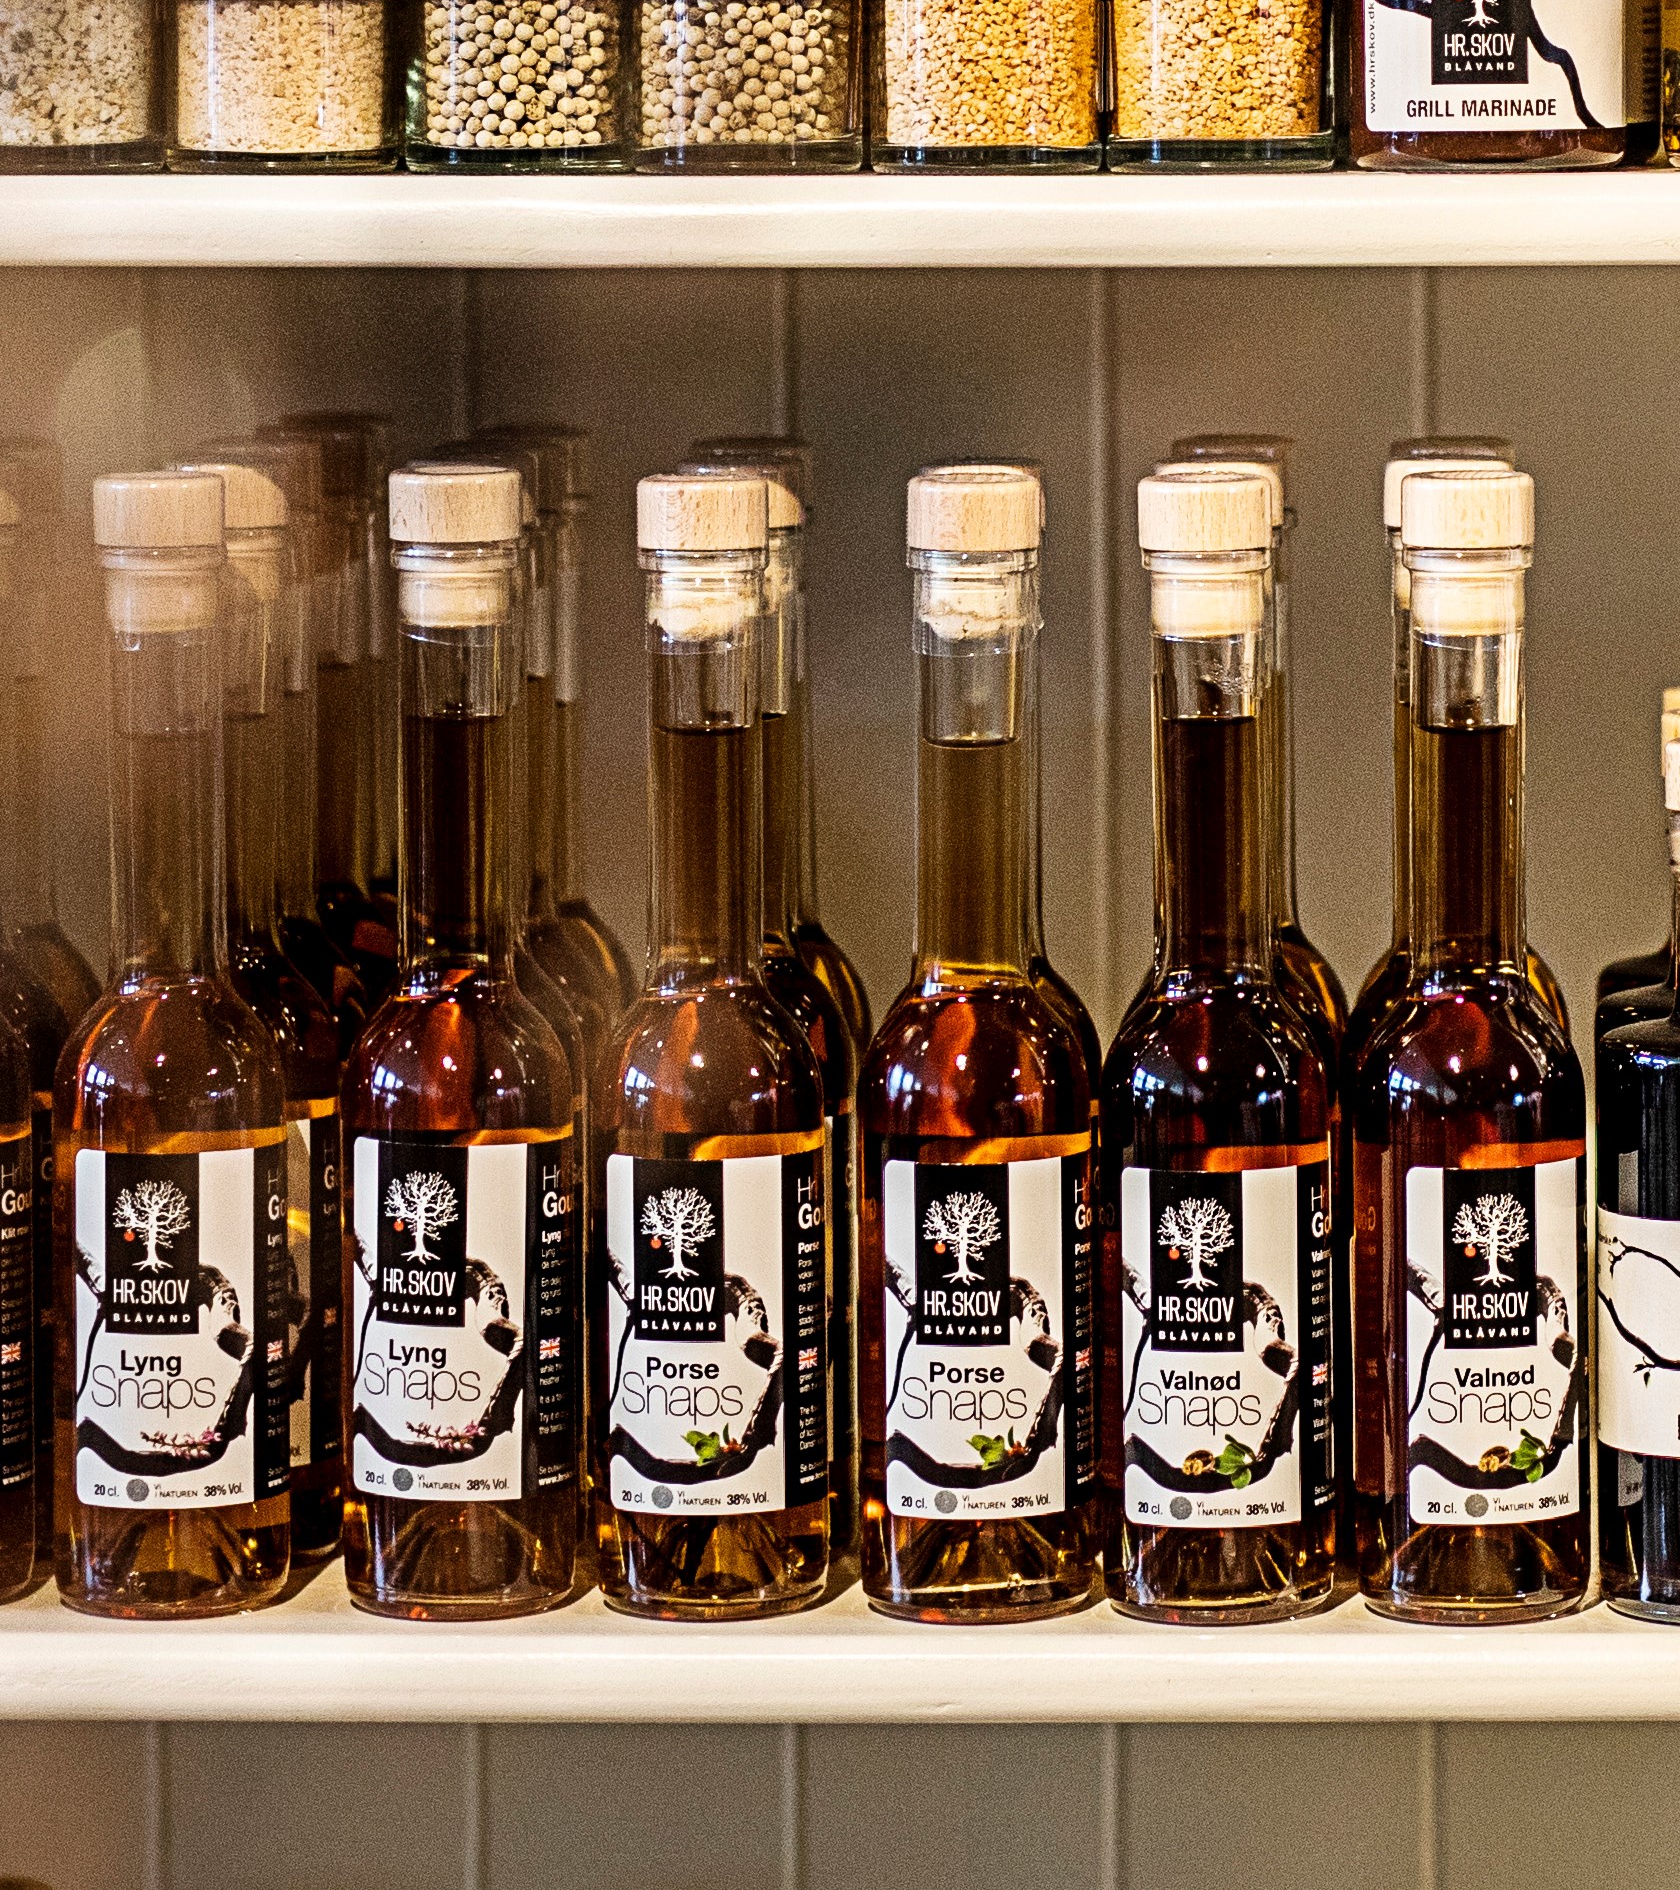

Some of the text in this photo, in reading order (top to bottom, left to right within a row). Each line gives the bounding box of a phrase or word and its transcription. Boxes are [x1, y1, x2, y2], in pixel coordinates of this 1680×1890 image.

[1406, 98, 1557, 118] GRILL MARINADE
[119, 1349, 182, 1378] Lyng
[929, 1362, 1004, 1383] Porse
[1160, 1369, 1240, 1390] Valnød
[90, 1364, 215, 1418] Snaps
[901, 1376, 1027, 1429] Snaps
[1137, 1382, 1261, 1434] Snaps
[93, 1482, 105, 1495] 20
[203, 1483, 226, 1497] 38%
